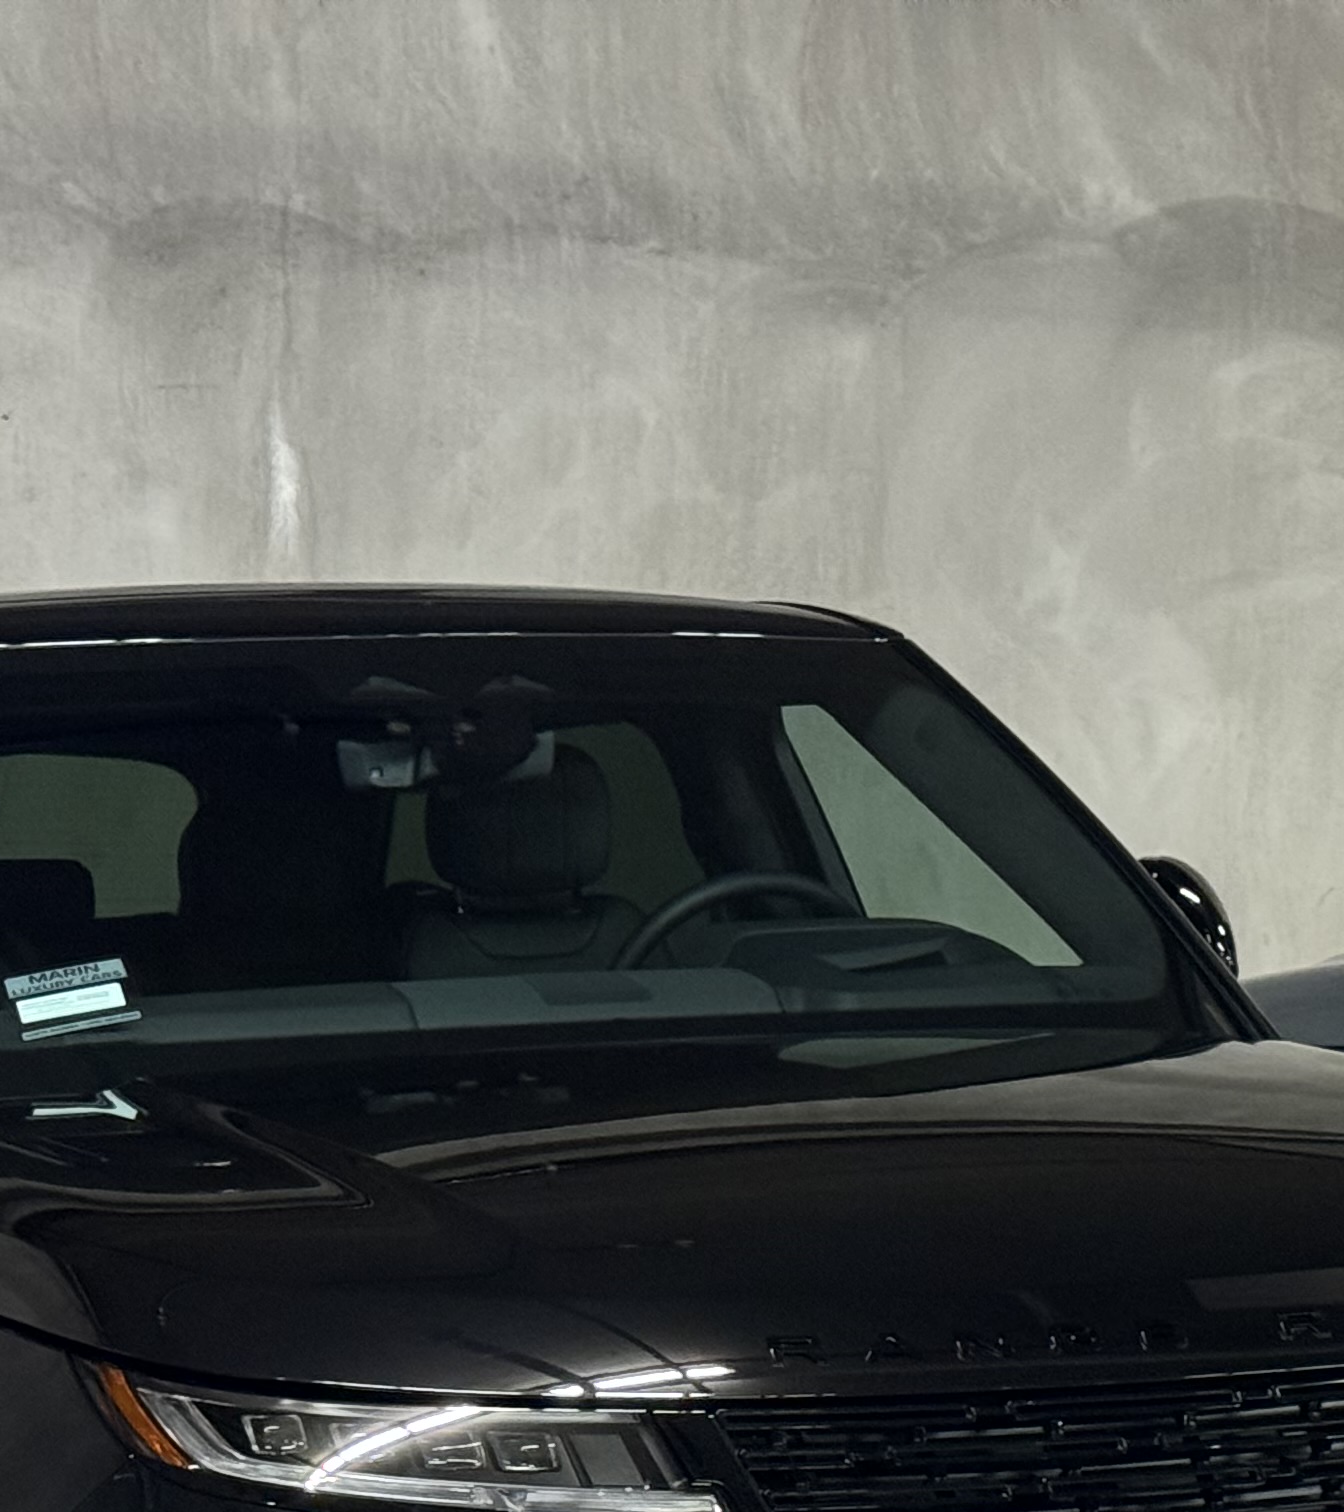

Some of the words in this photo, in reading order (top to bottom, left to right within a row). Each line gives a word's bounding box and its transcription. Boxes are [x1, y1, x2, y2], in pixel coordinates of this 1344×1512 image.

[12, 979, 74, 996] LUXURY
[81, 970, 122, 983] CARS
[29, 964, 100, 985] MARIN
